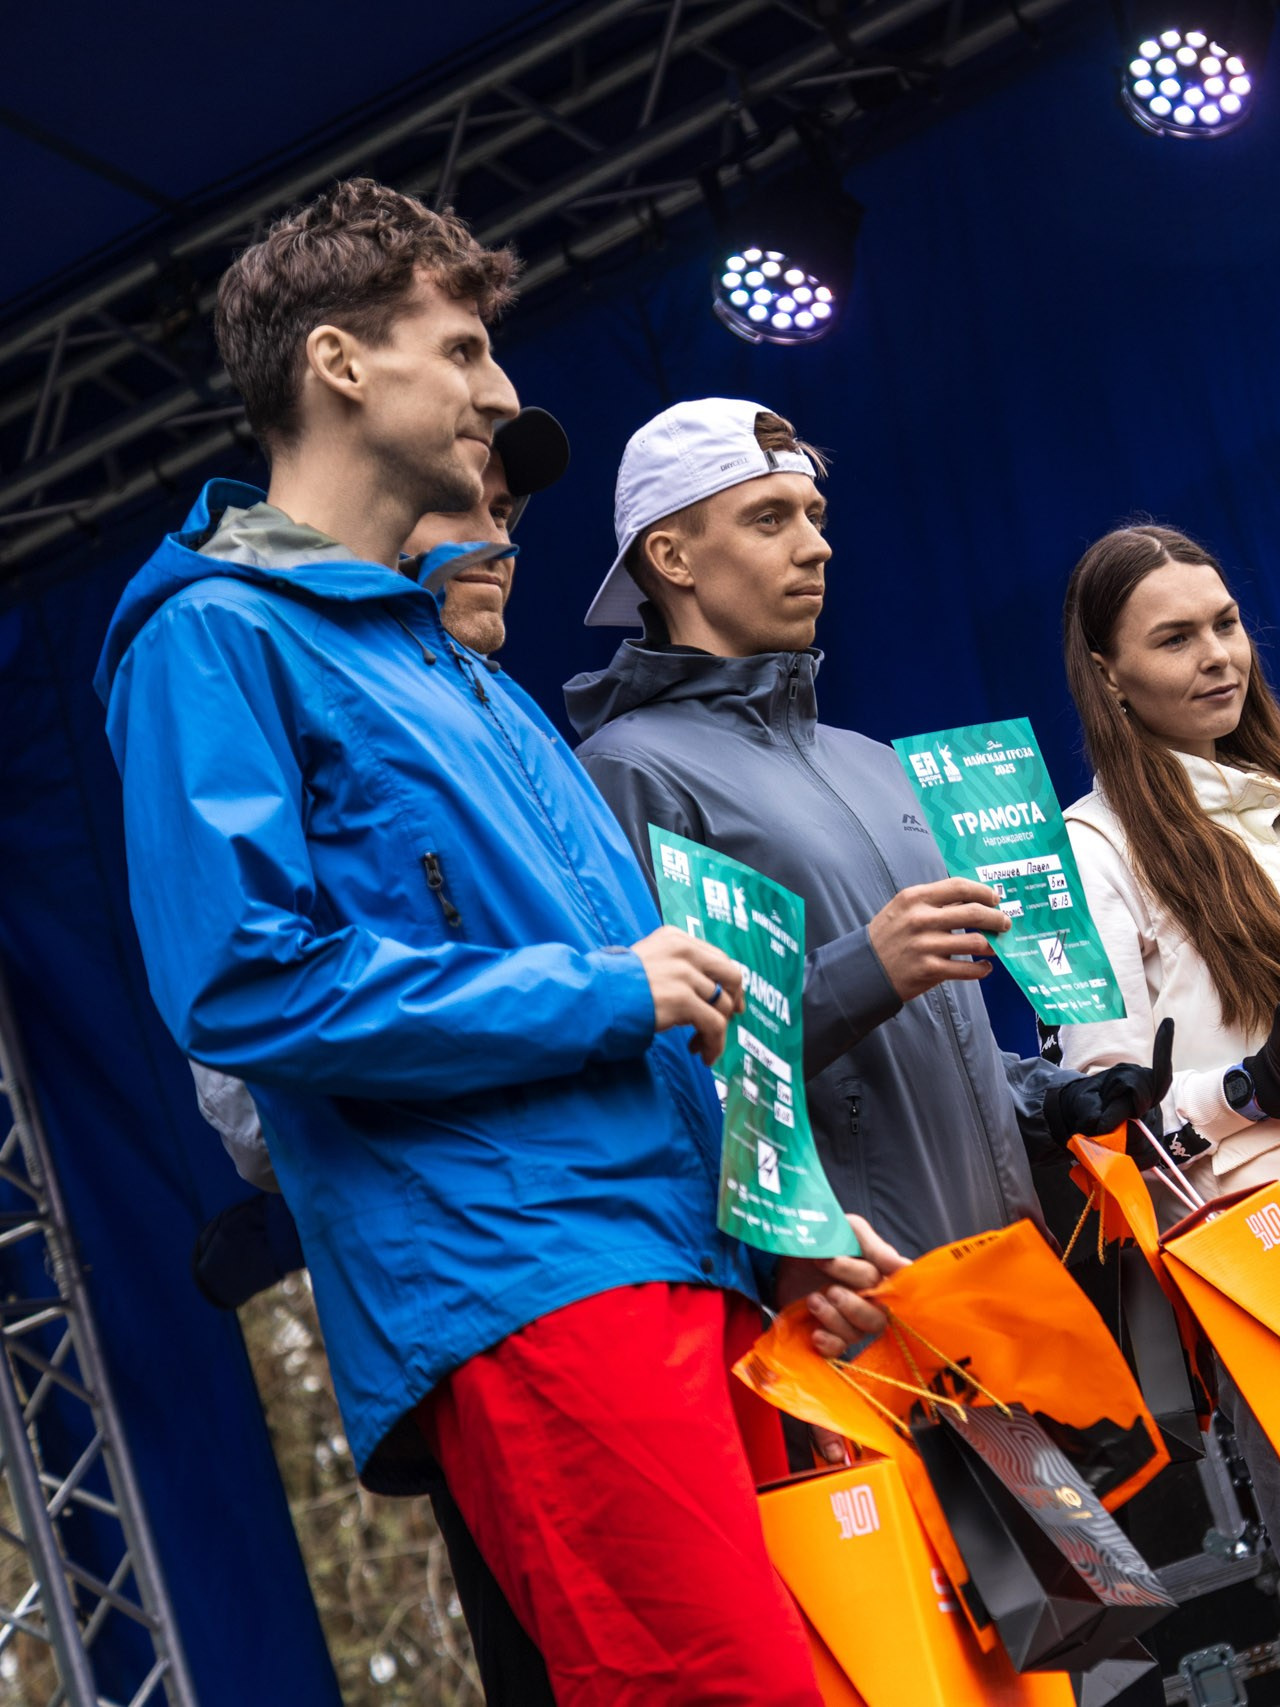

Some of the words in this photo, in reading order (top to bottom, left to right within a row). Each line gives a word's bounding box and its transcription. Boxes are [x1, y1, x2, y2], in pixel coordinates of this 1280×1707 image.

[962, 751, 1006, 767] МАЙСКАЯ
[1006, 747, 1034, 760] ГРОЗА
[993, 763, 1016, 776] 2025
[952, 801, 1047, 837] ГРАМОТА
[983, 831, 1035, 847] Награждается
[1026, 862, 1050, 876] Павел
